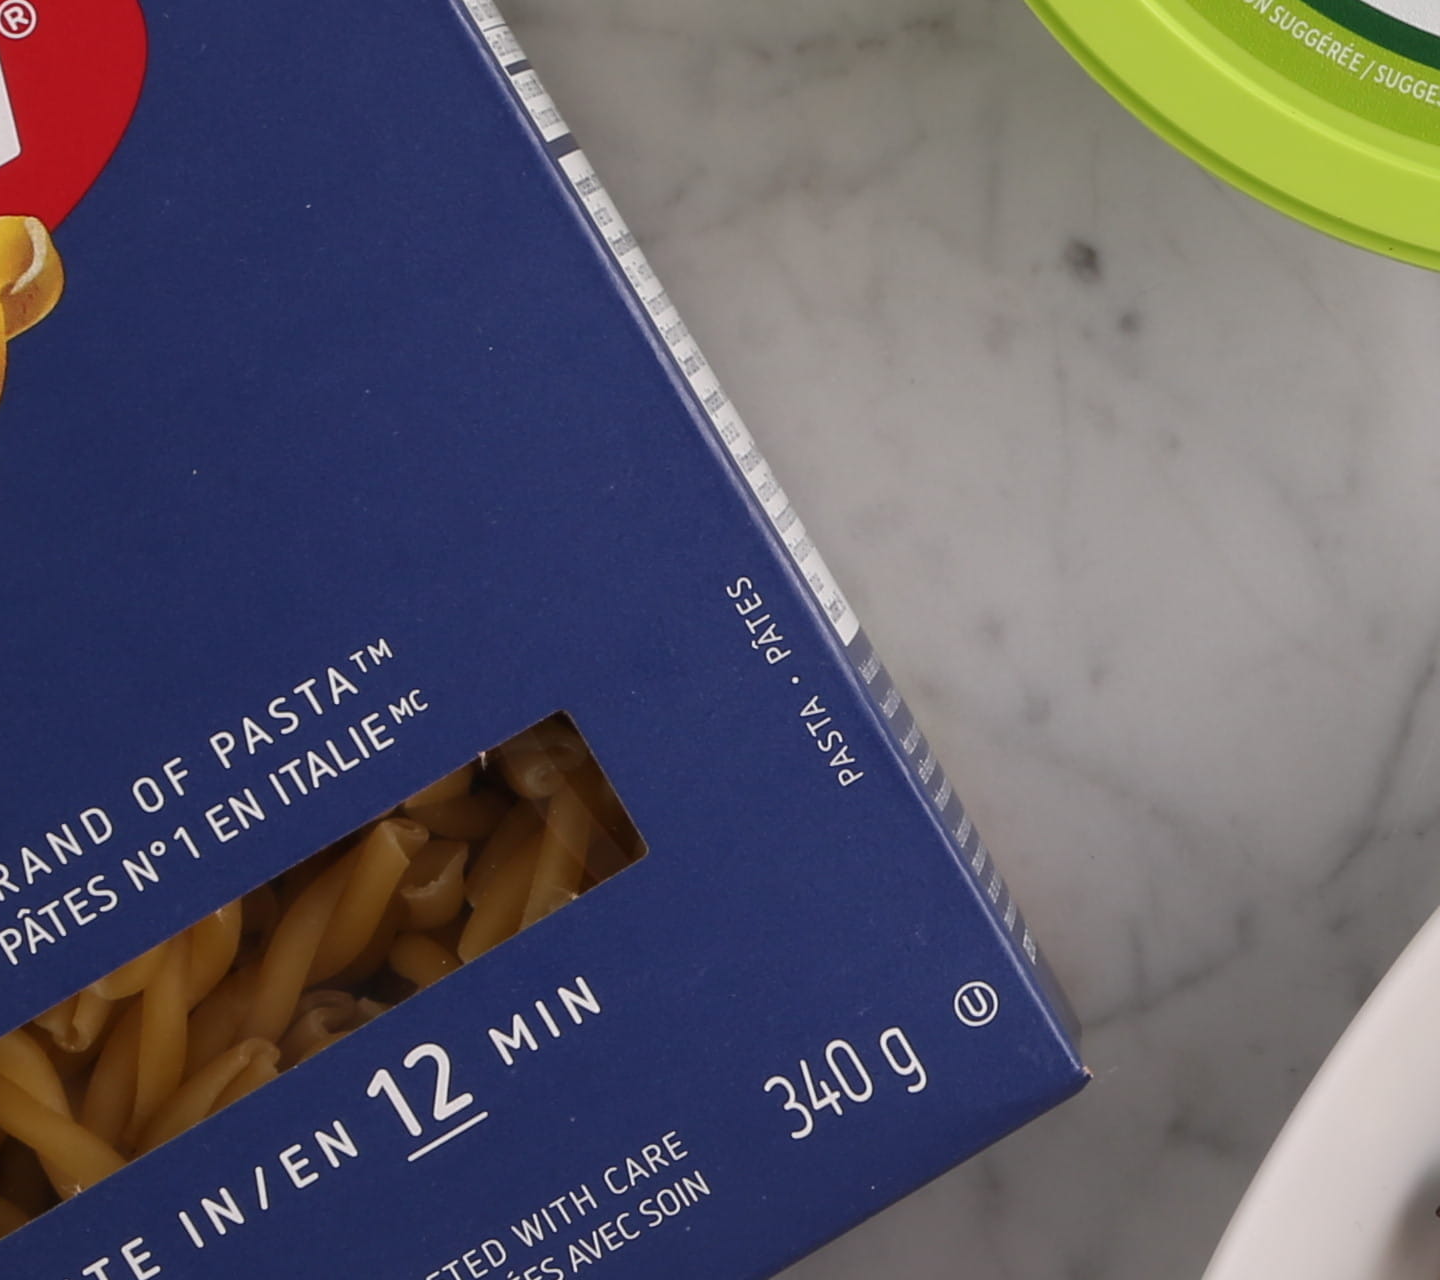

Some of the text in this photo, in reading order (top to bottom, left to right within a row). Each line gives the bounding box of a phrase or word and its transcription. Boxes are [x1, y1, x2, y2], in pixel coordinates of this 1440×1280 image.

[1268, 6, 1363, 74] SUGGÉRÉE
[727, 577, 791, 664] PÂTES
[133, 758, 187, 812] OF
[800, 696, 863, 786] PASTA
[206, 789, 264, 842] EN
[367, 1044, 473, 1136] 12
[489, 977, 600, 1065] MIN
[764, 1028, 926, 1138] 340 g
[511, 1185, 597, 1246] WITH
[604, 1131, 687, 1194] CARE
[569, 1213, 640, 1272] AVEC
[640, 1171, 710, 1227] SOIN
